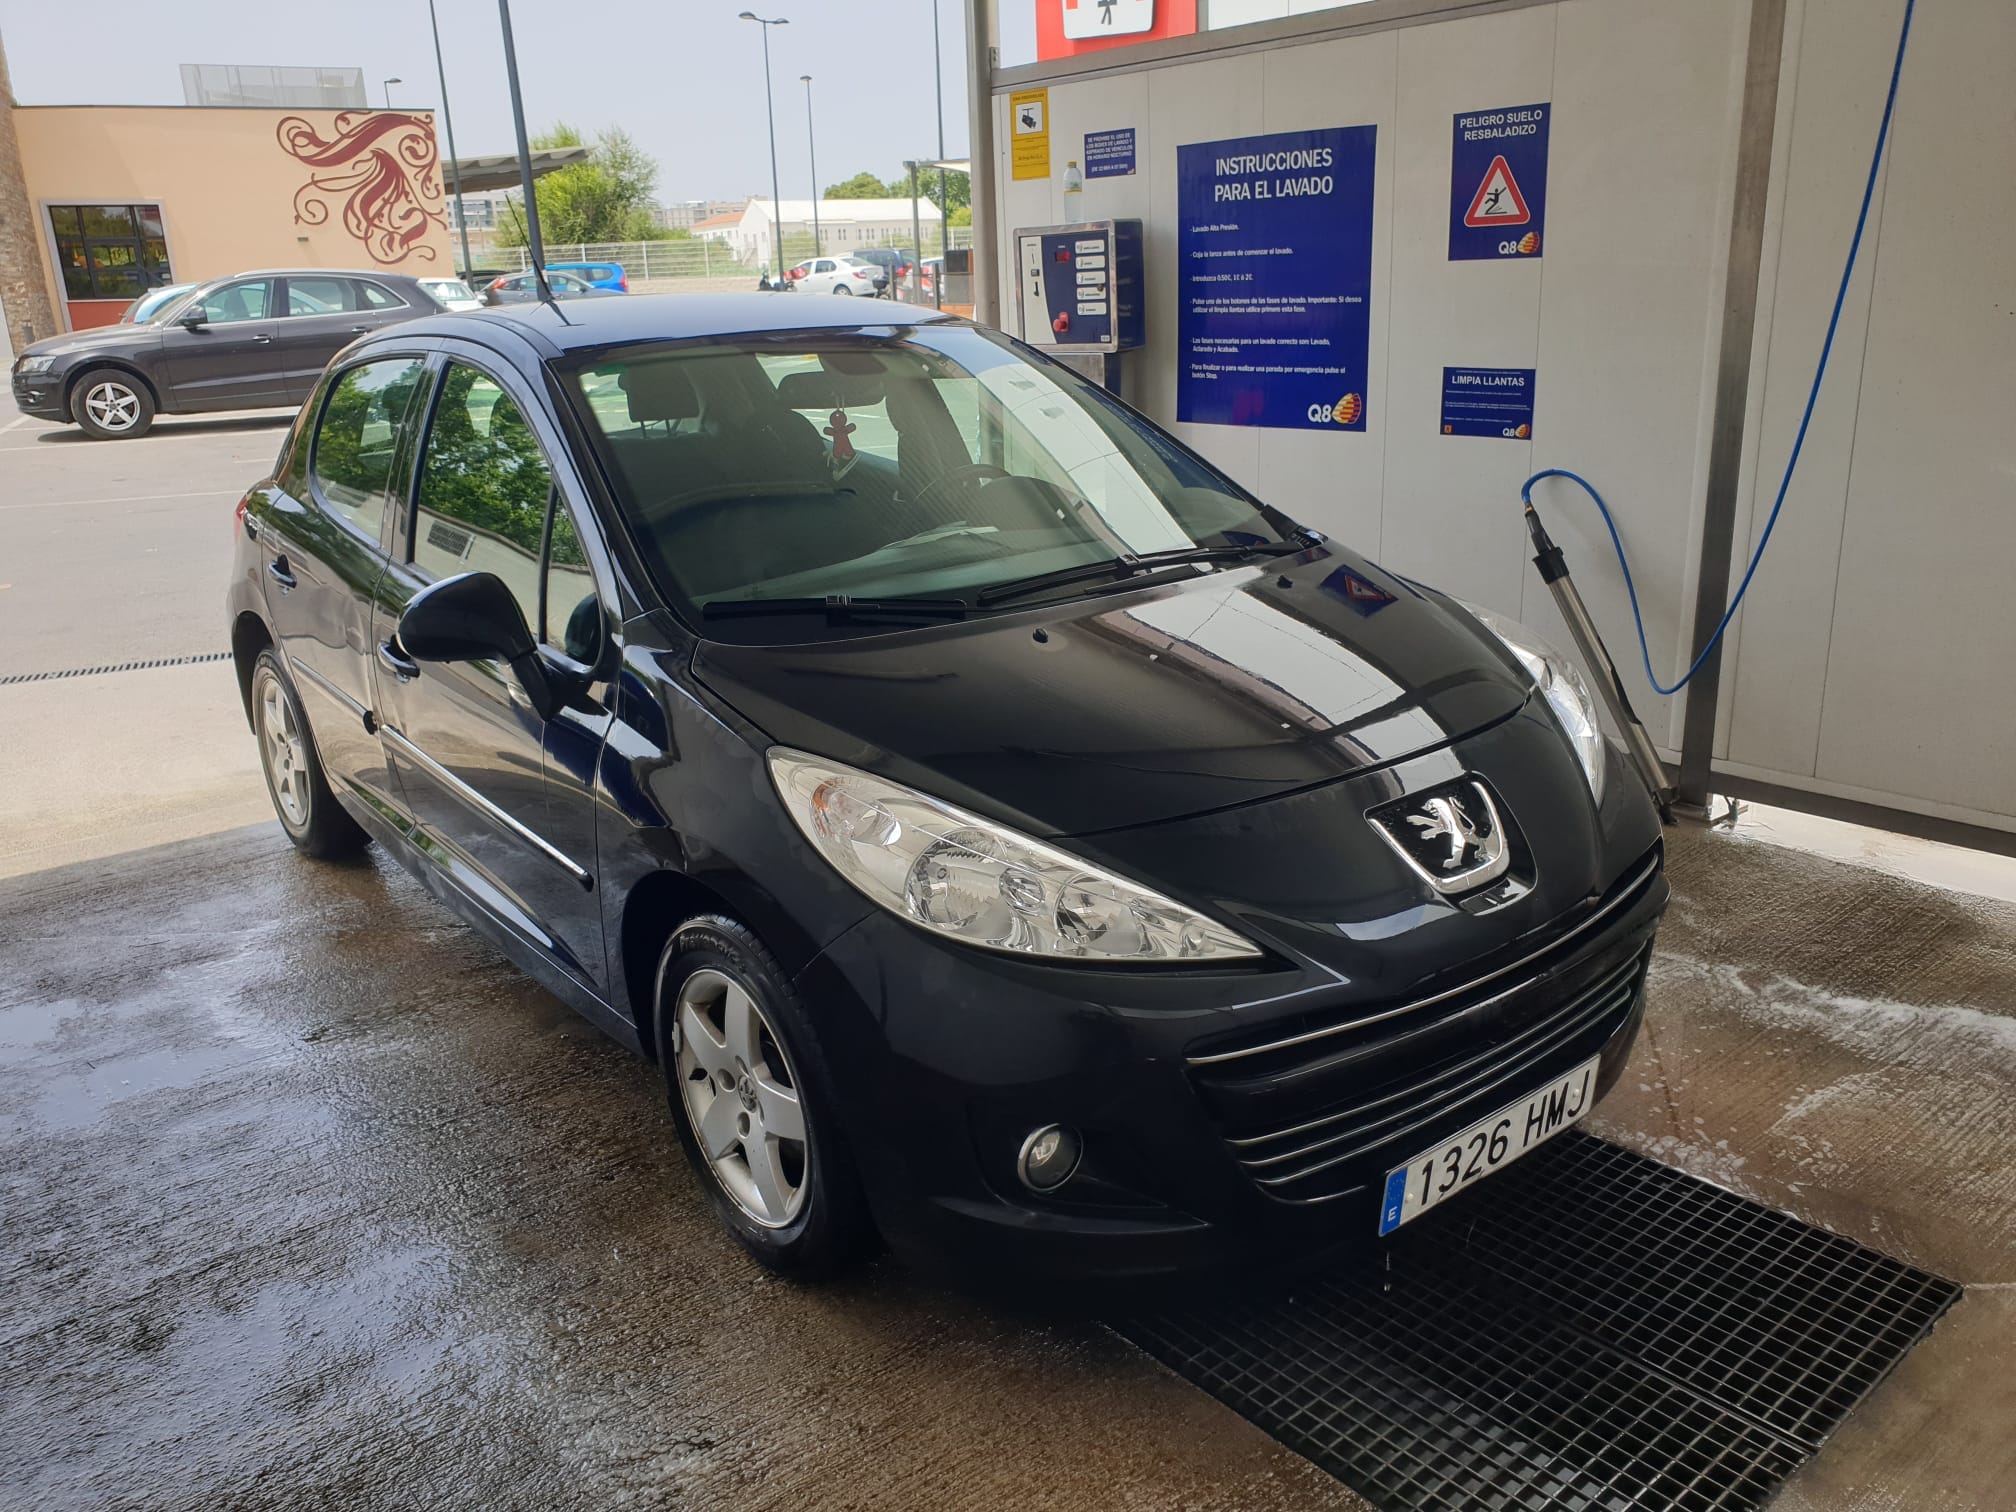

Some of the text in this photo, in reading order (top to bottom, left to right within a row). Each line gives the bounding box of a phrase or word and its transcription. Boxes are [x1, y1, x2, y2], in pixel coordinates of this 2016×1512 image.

[1460, 110, 1542, 128] PELIGRO SUELO
[1465, 124, 1537, 141] RESBALADIZO
[1216, 149, 1332, 176] INSTRUCCIONES
[1215, 176, 1333, 202] PARA EL LAVADO
[1193, 225, 1209, 233] Lavado
[1192, 251, 1203, 259] Coja
[1499, 241, 1517, 255] Q8
[1214, 306, 1228, 314] limpia
[1260, 337, 1276, 345] lavado
[1203, 363, 1220, 371] finalizar
[1225, 365, 1236, 373] para
[1237, 364, 1255, 372] realizar
[1294, 366, 1324, 374] emergencia
[1325, 366, 1339, 375] pulse
[1452, 375, 1525, 386] LIMPIA LLANTAS
[1307, 404, 1331, 423] Q8
[1421, 1070, 1590, 1206] 1326 HMJ
[1388, 1206, 1398, 1222] E
